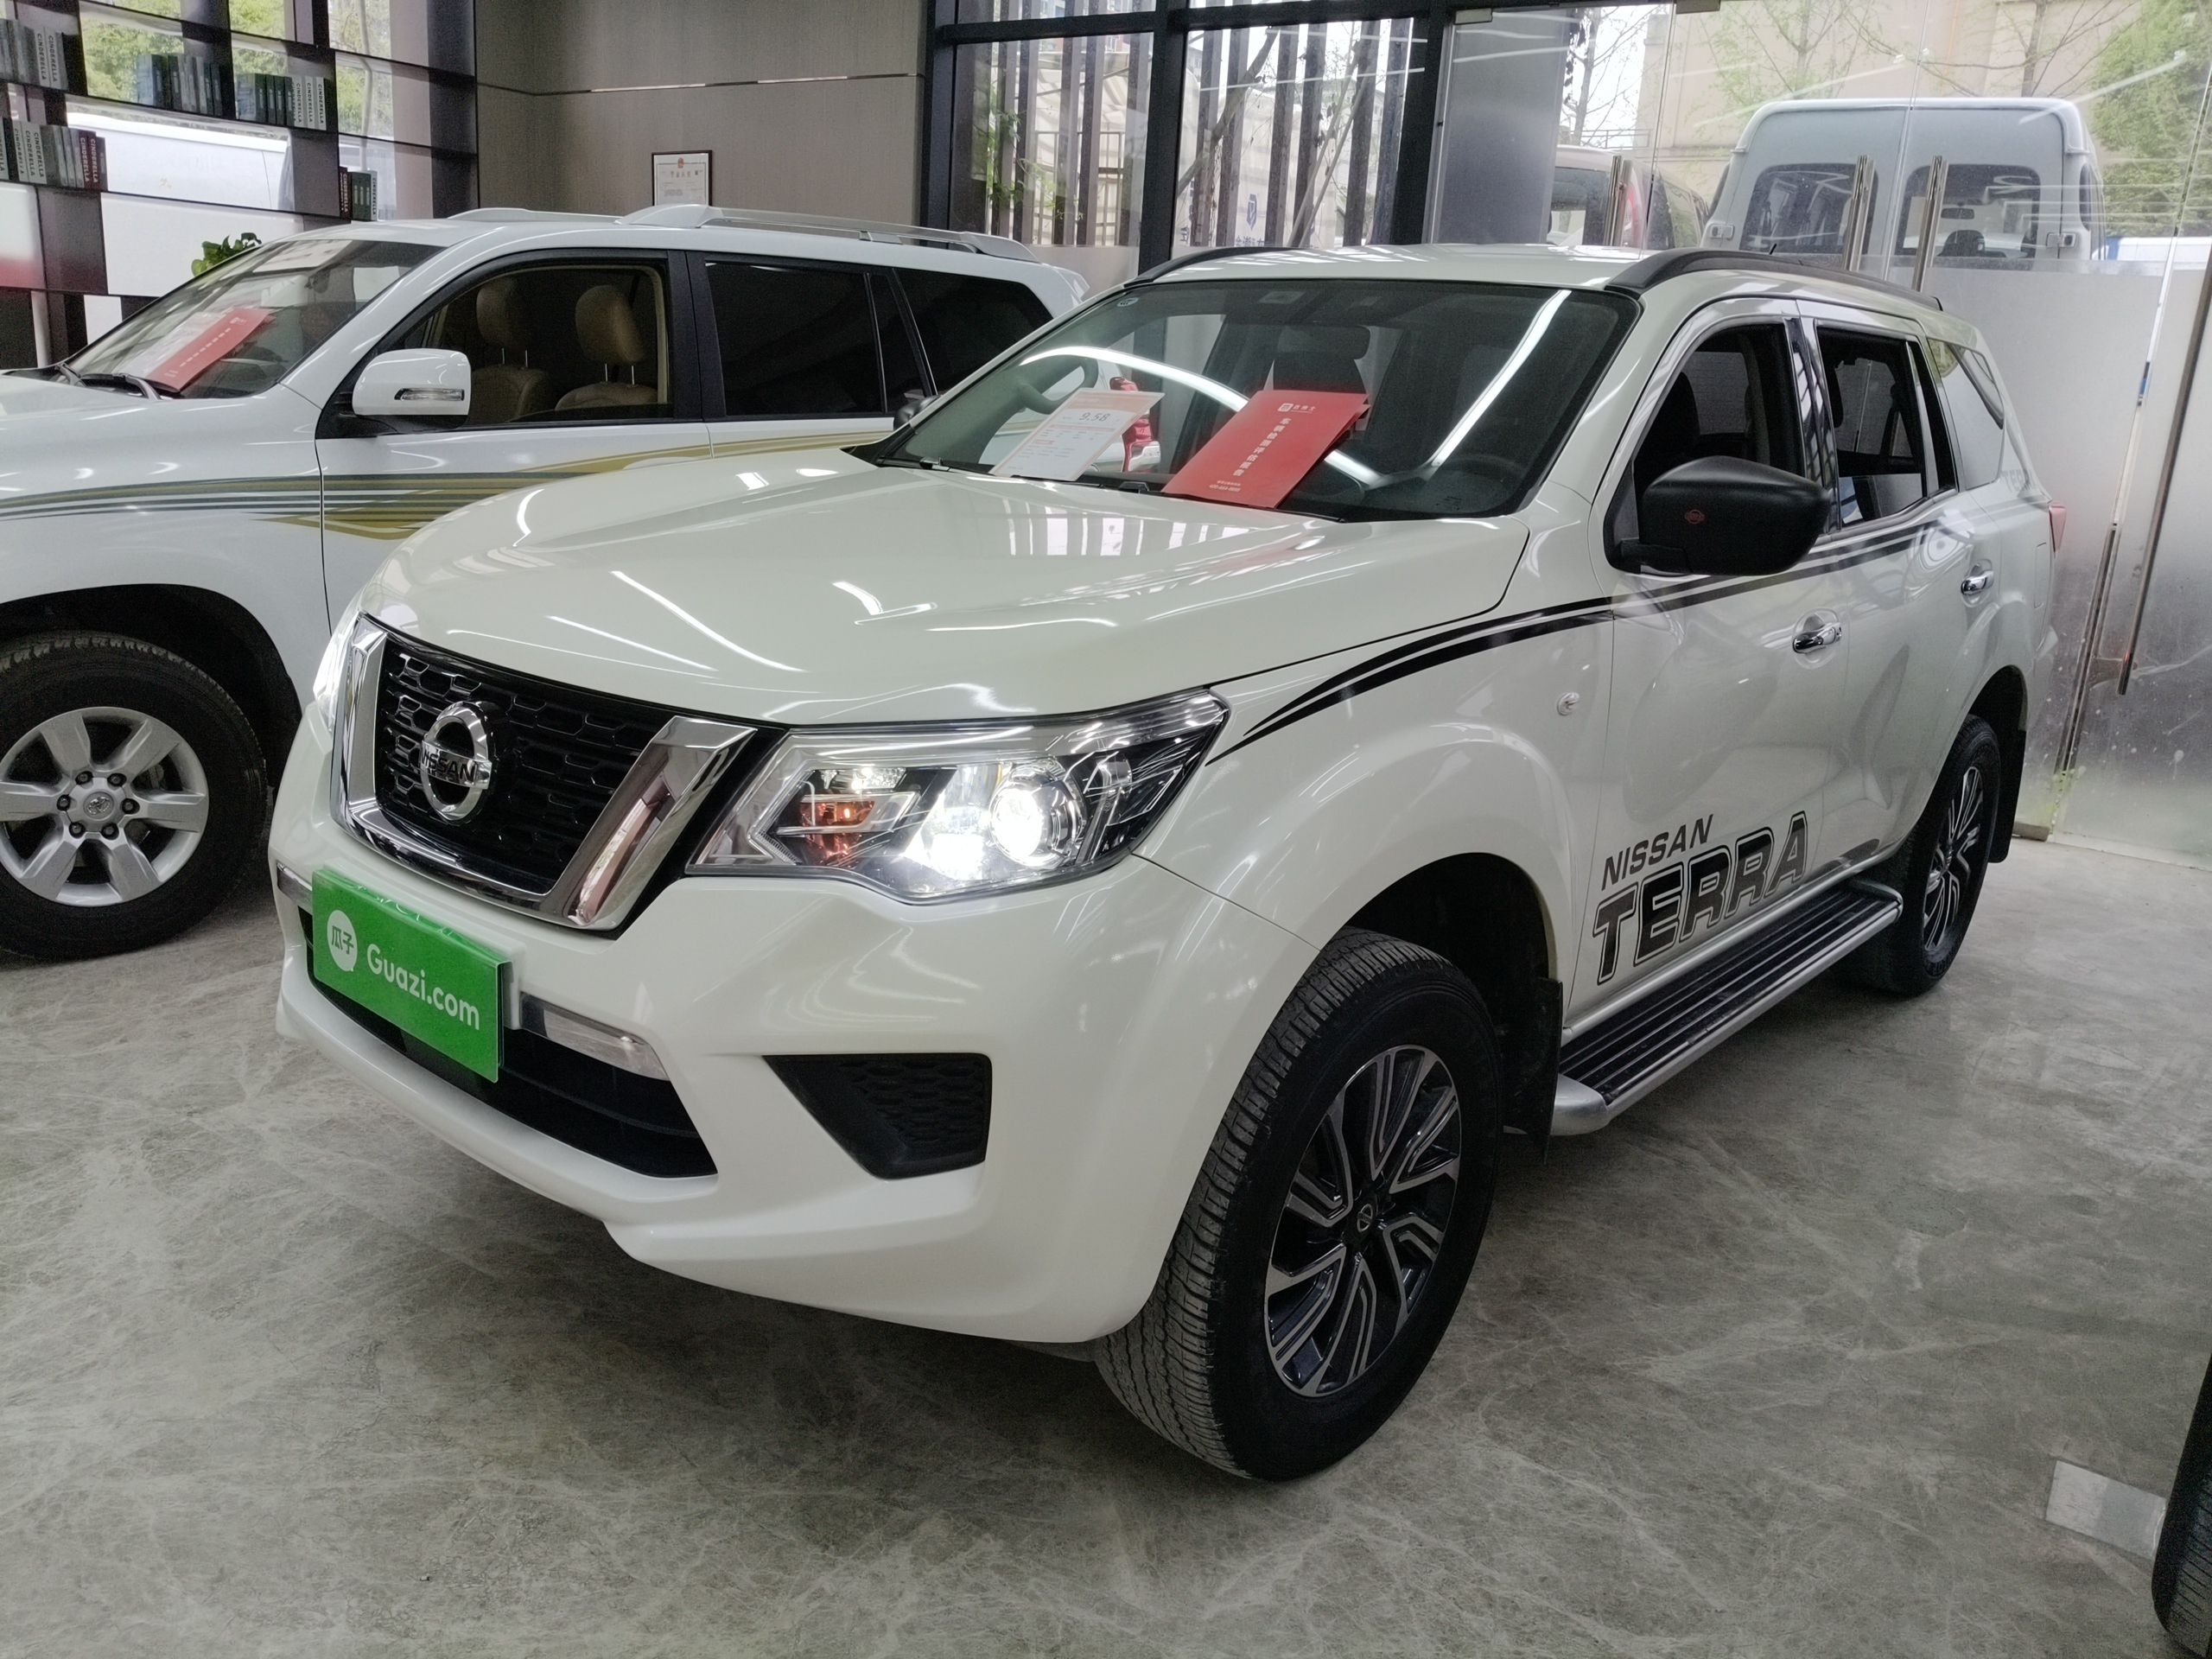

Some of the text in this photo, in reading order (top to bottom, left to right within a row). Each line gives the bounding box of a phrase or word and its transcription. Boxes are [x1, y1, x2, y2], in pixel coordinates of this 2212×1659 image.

[422, 747, 478, 782] NISSAN
[1602, 814, 1713, 891] NISSAN
[1592, 810, 1808, 986] TERRA
[331, 925, 354, 955] 瓜子
[366, 944, 480, 1031] Guazi.com
